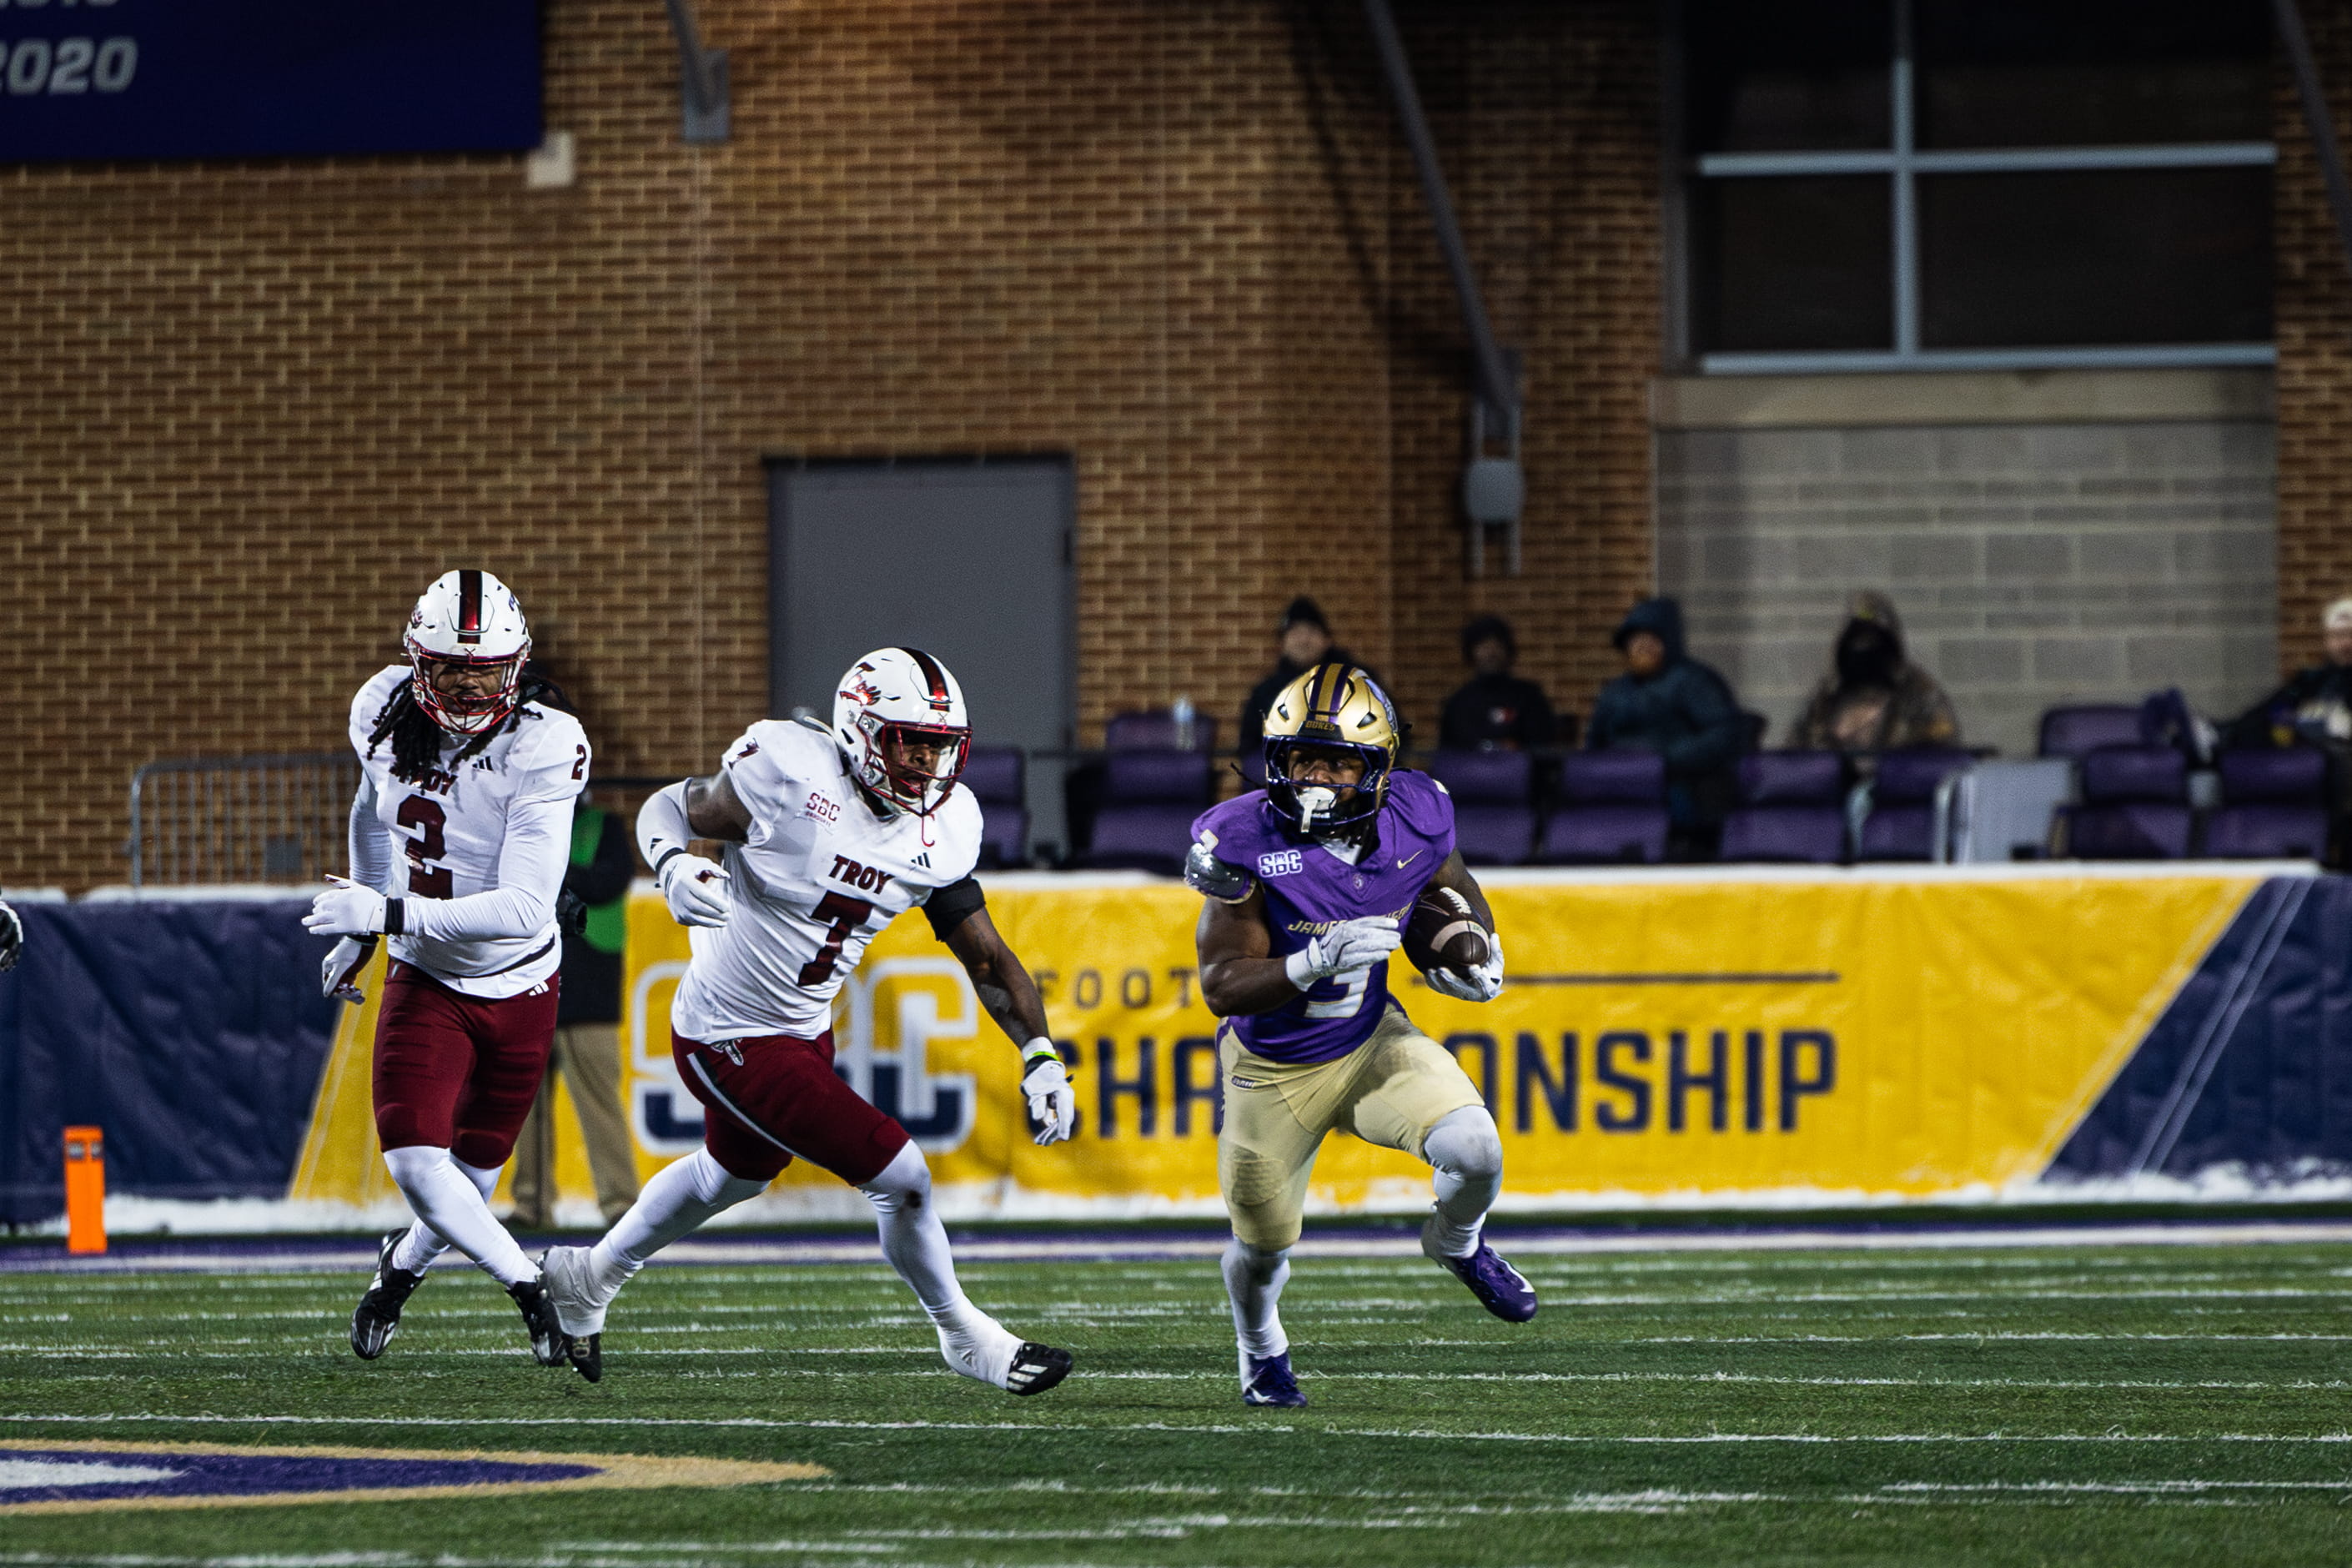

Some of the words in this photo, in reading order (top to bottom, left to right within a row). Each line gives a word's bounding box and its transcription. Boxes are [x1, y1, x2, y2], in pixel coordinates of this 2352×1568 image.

[0, 38, 138, 93] 020
[399, 767, 459, 796] OY
[570, 744, 586, 781] 2
[806, 792, 841, 822] SBC
[396, 793, 453, 901] 2
[1258, 849, 1303, 877] SBC
[828, 853, 895, 895] TROY
[798, 889, 873, 987] 7
[1033, 968, 1199, 1010] FOOT
